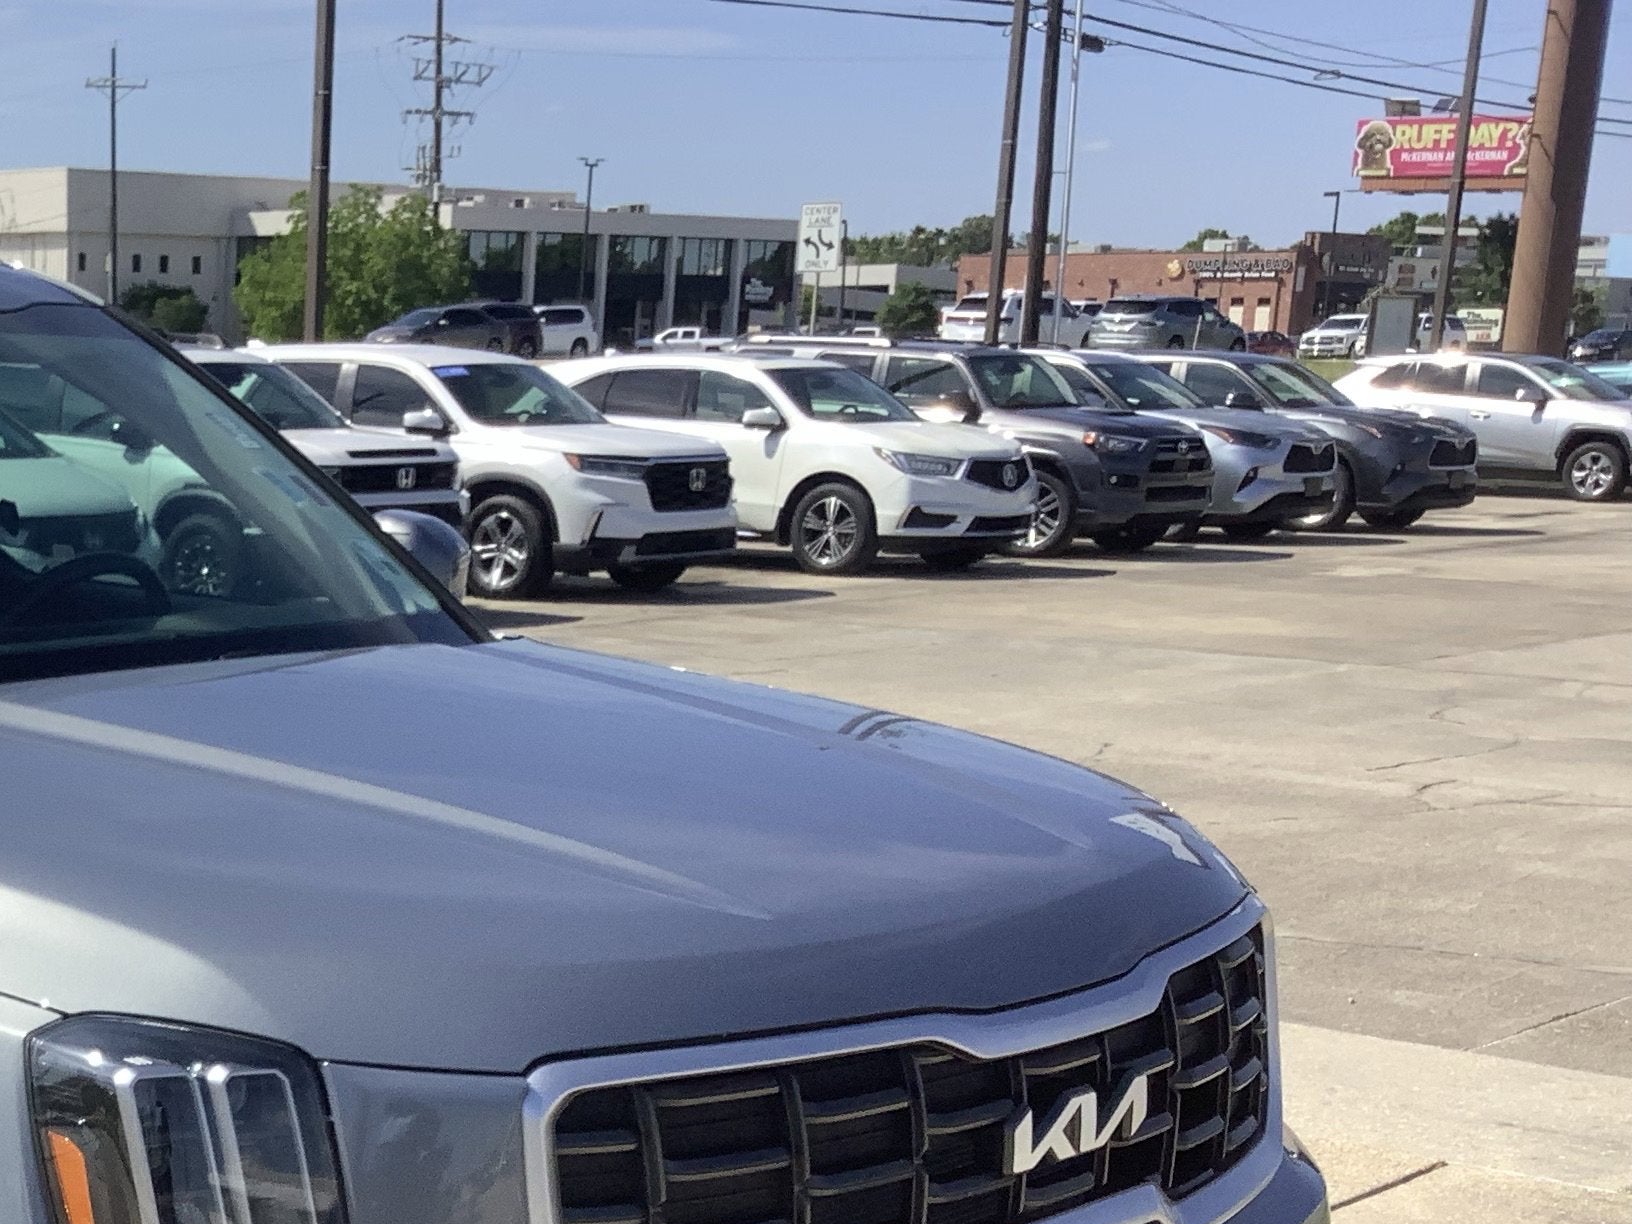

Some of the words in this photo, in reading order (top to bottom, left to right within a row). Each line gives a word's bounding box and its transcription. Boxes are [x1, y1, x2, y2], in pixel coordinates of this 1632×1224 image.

[1395, 123, 1457, 148] RUFF
[1400, 150, 1444, 161] McKERNAN
[805, 206, 839, 215] CENTER
[809, 216, 833, 225] LANE
[805, 260, 829, 269] ONLY
[1264, 259, 1290, 269] BAO
